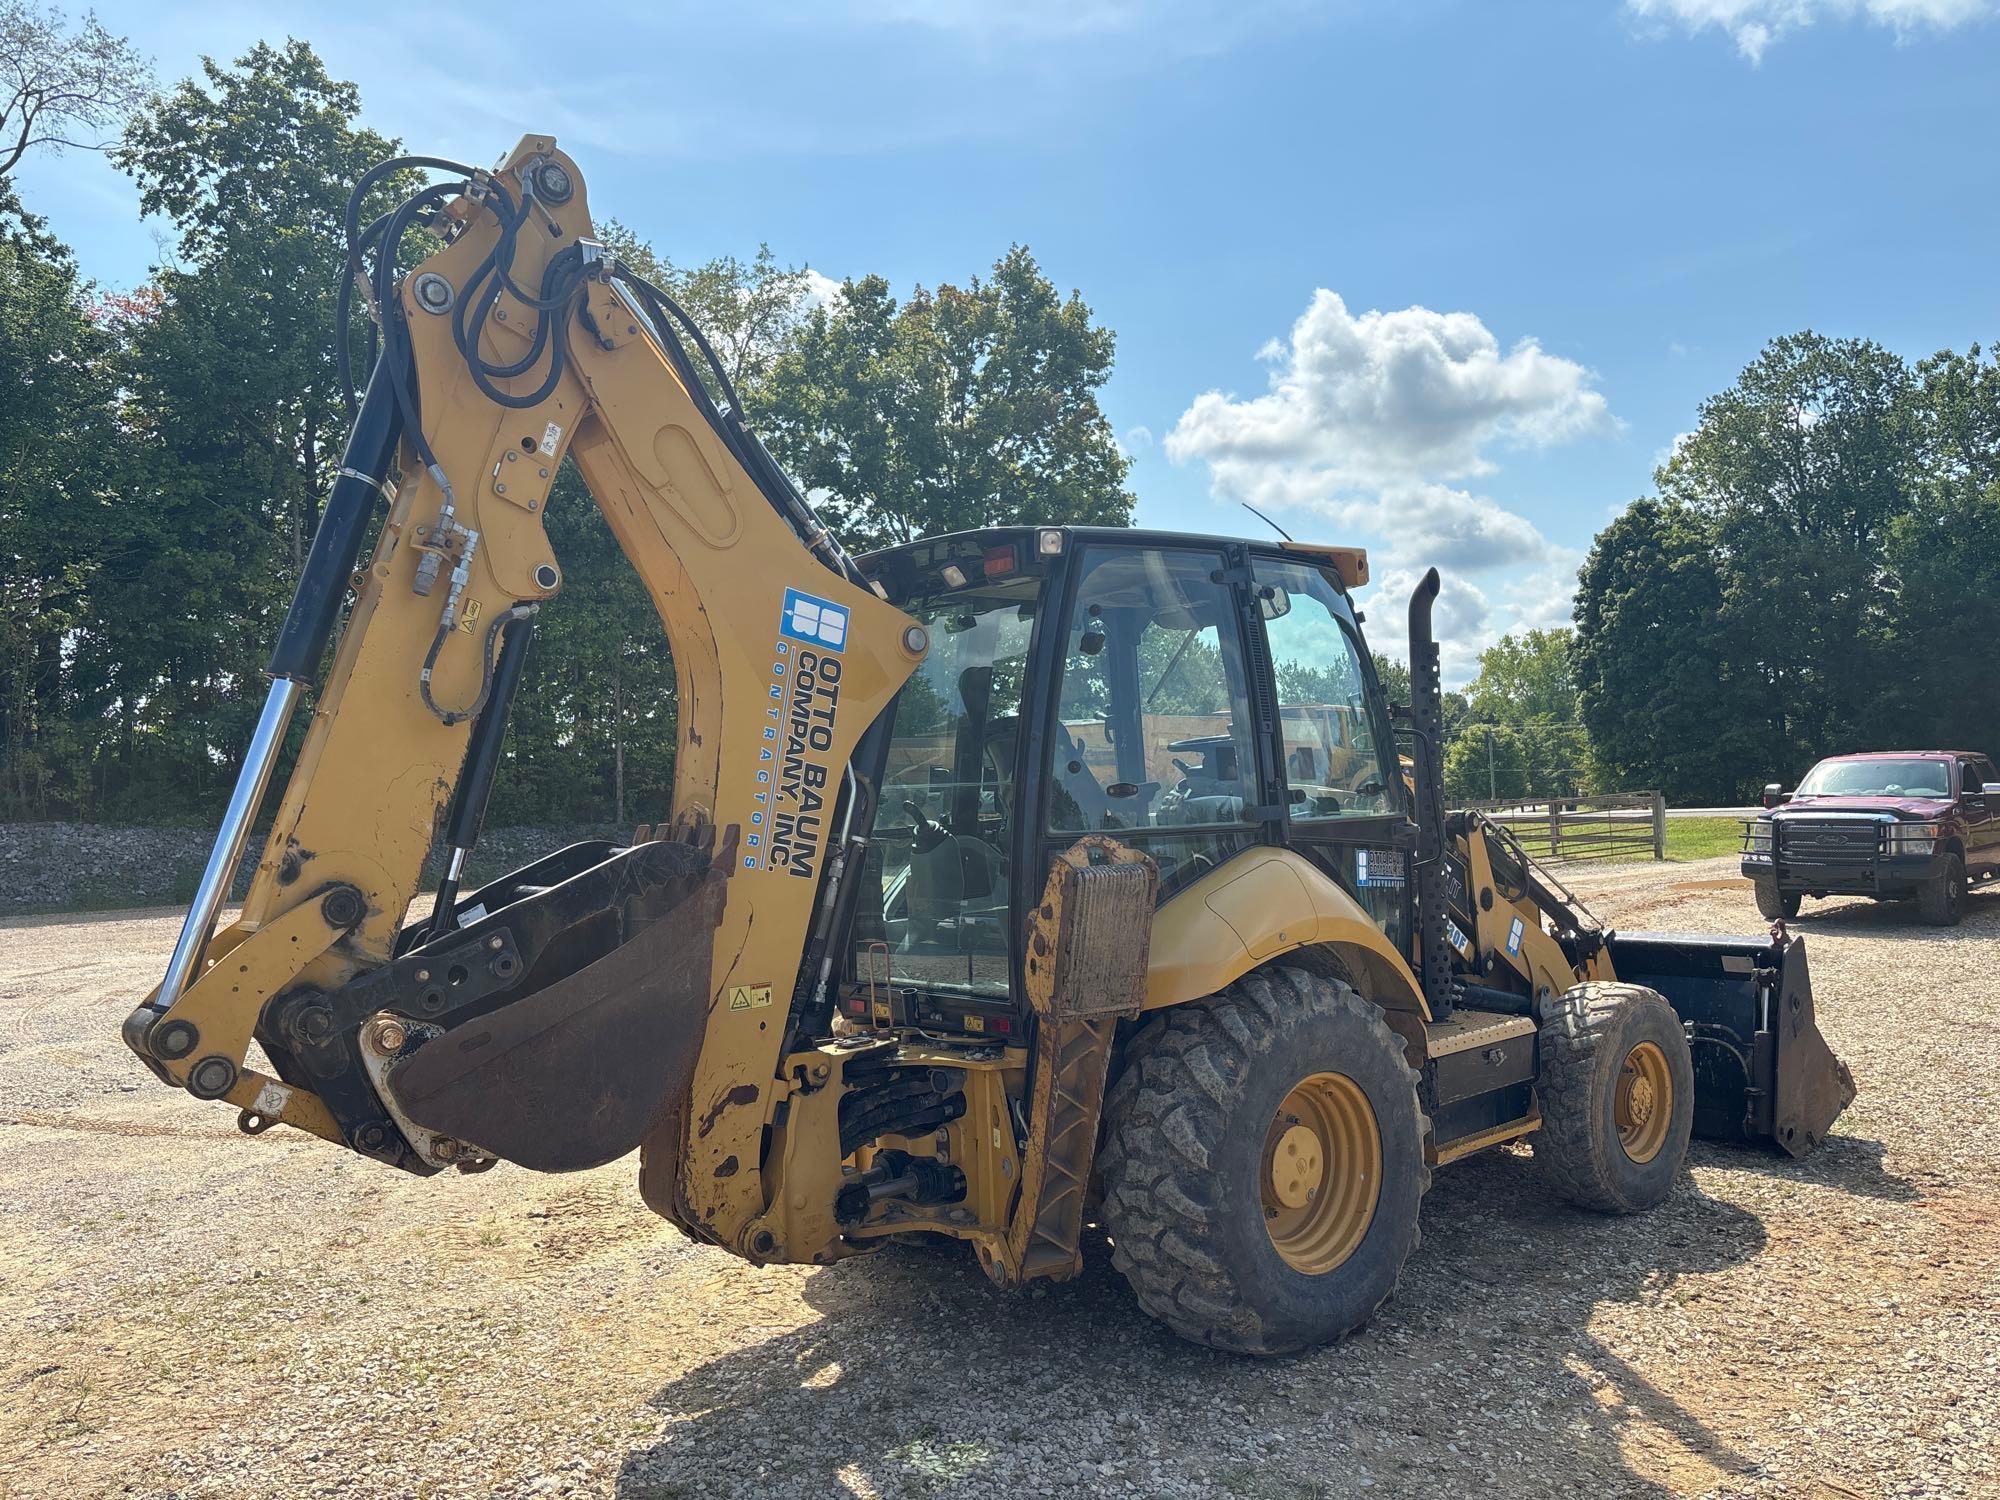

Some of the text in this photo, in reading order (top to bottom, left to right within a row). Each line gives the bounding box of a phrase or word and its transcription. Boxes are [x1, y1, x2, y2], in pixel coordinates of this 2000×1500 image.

[744, 641, 788, 869] CONTRACTORS
[768, 650, 817, 872] COMPANY, INC.
[789, 656, 842, 879] OTTO BAUM
